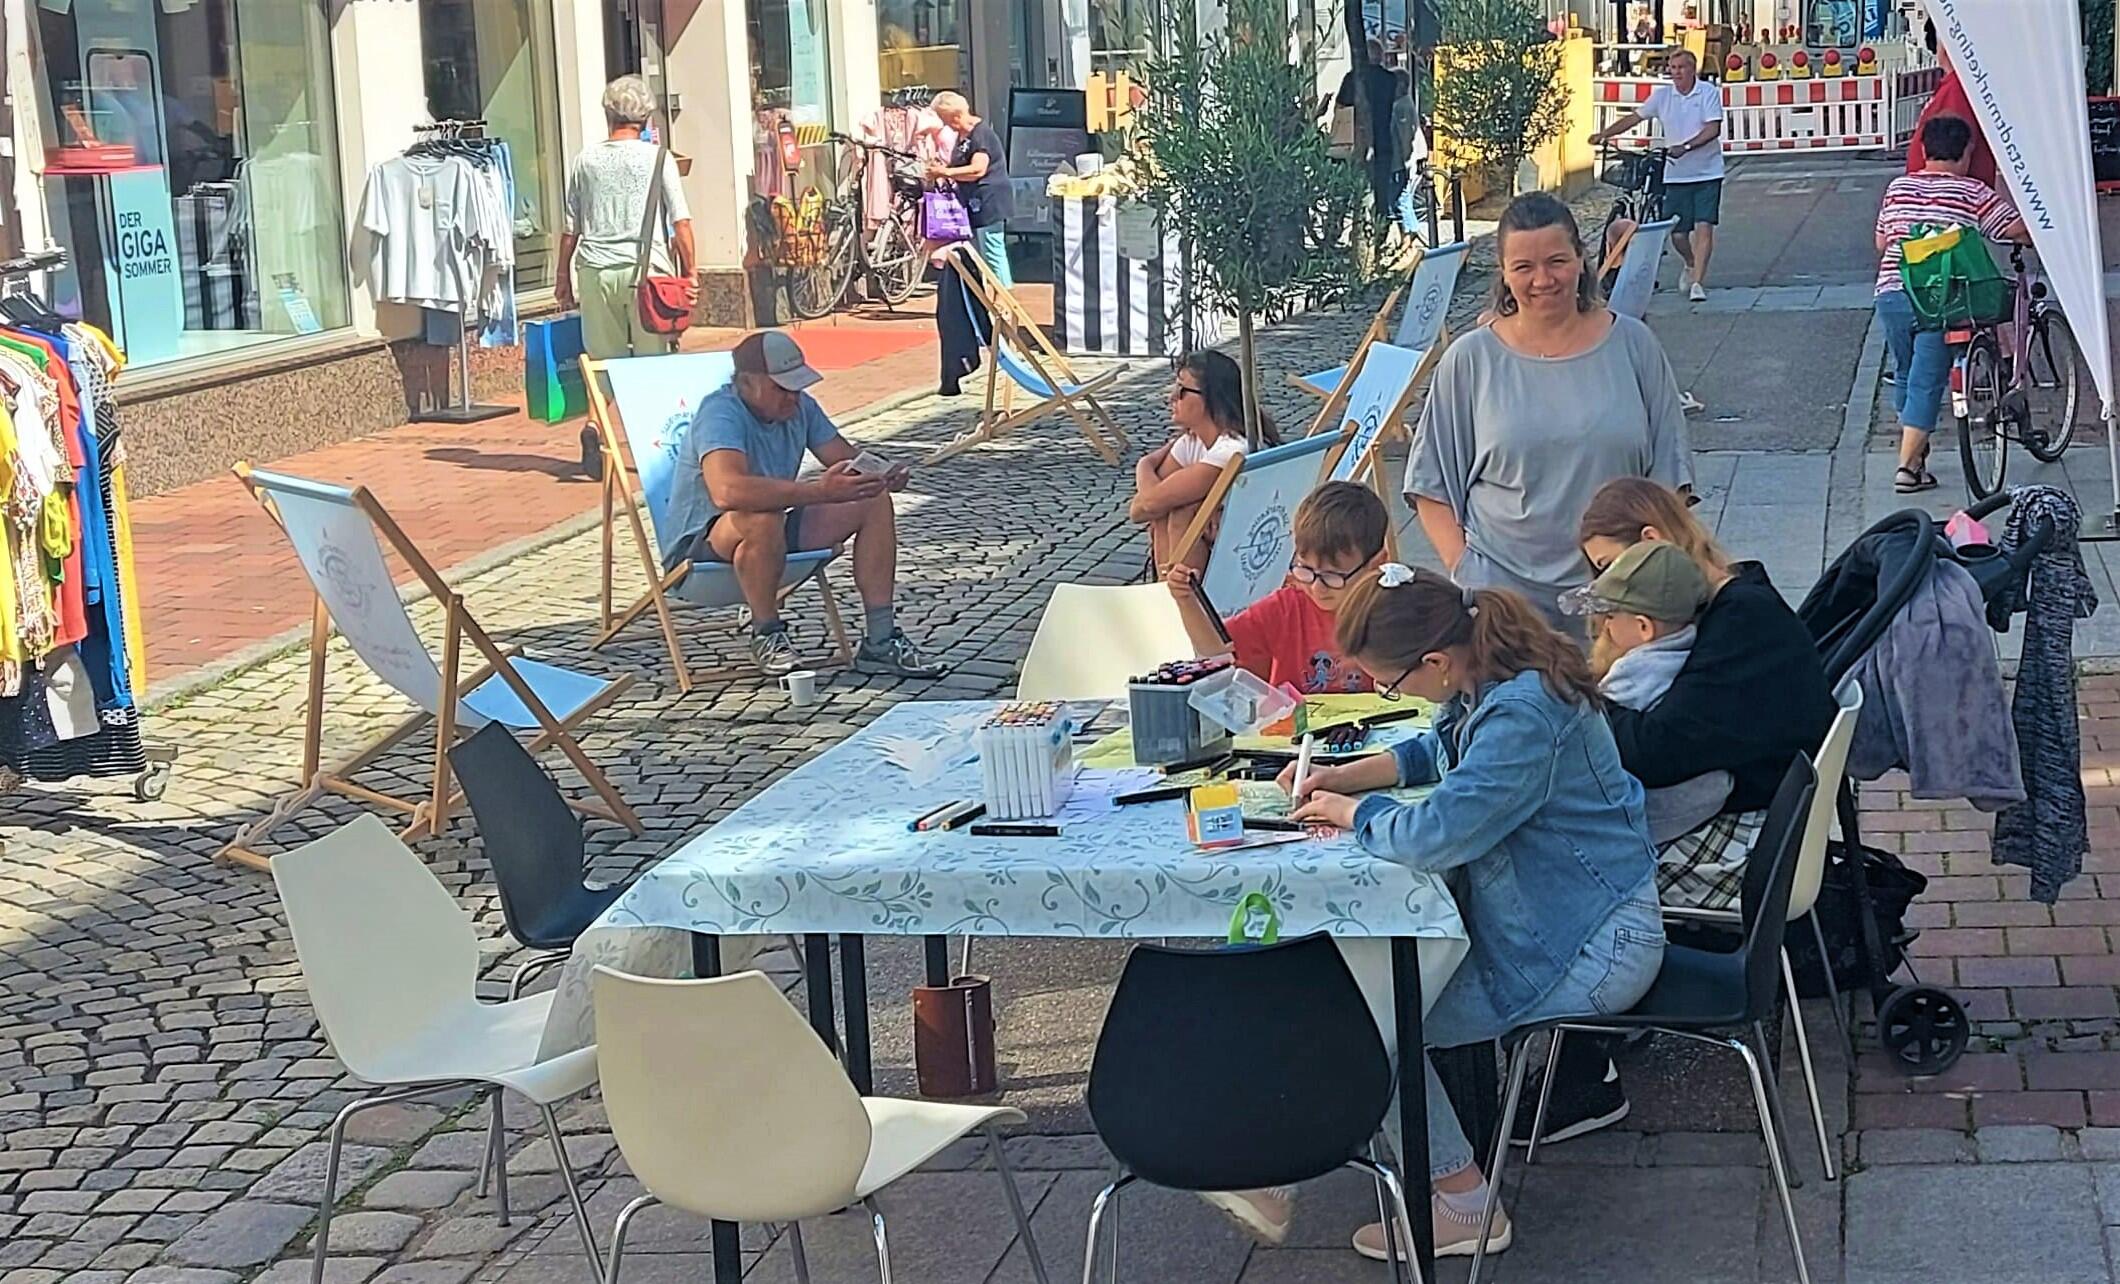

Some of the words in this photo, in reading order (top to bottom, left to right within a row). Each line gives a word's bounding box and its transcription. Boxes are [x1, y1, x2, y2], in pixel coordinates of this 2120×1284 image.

[119, 211, 142, 229] DER
[121, 229, 168, 259] GIGA
[124, 258, 172, 279] SOMMER
